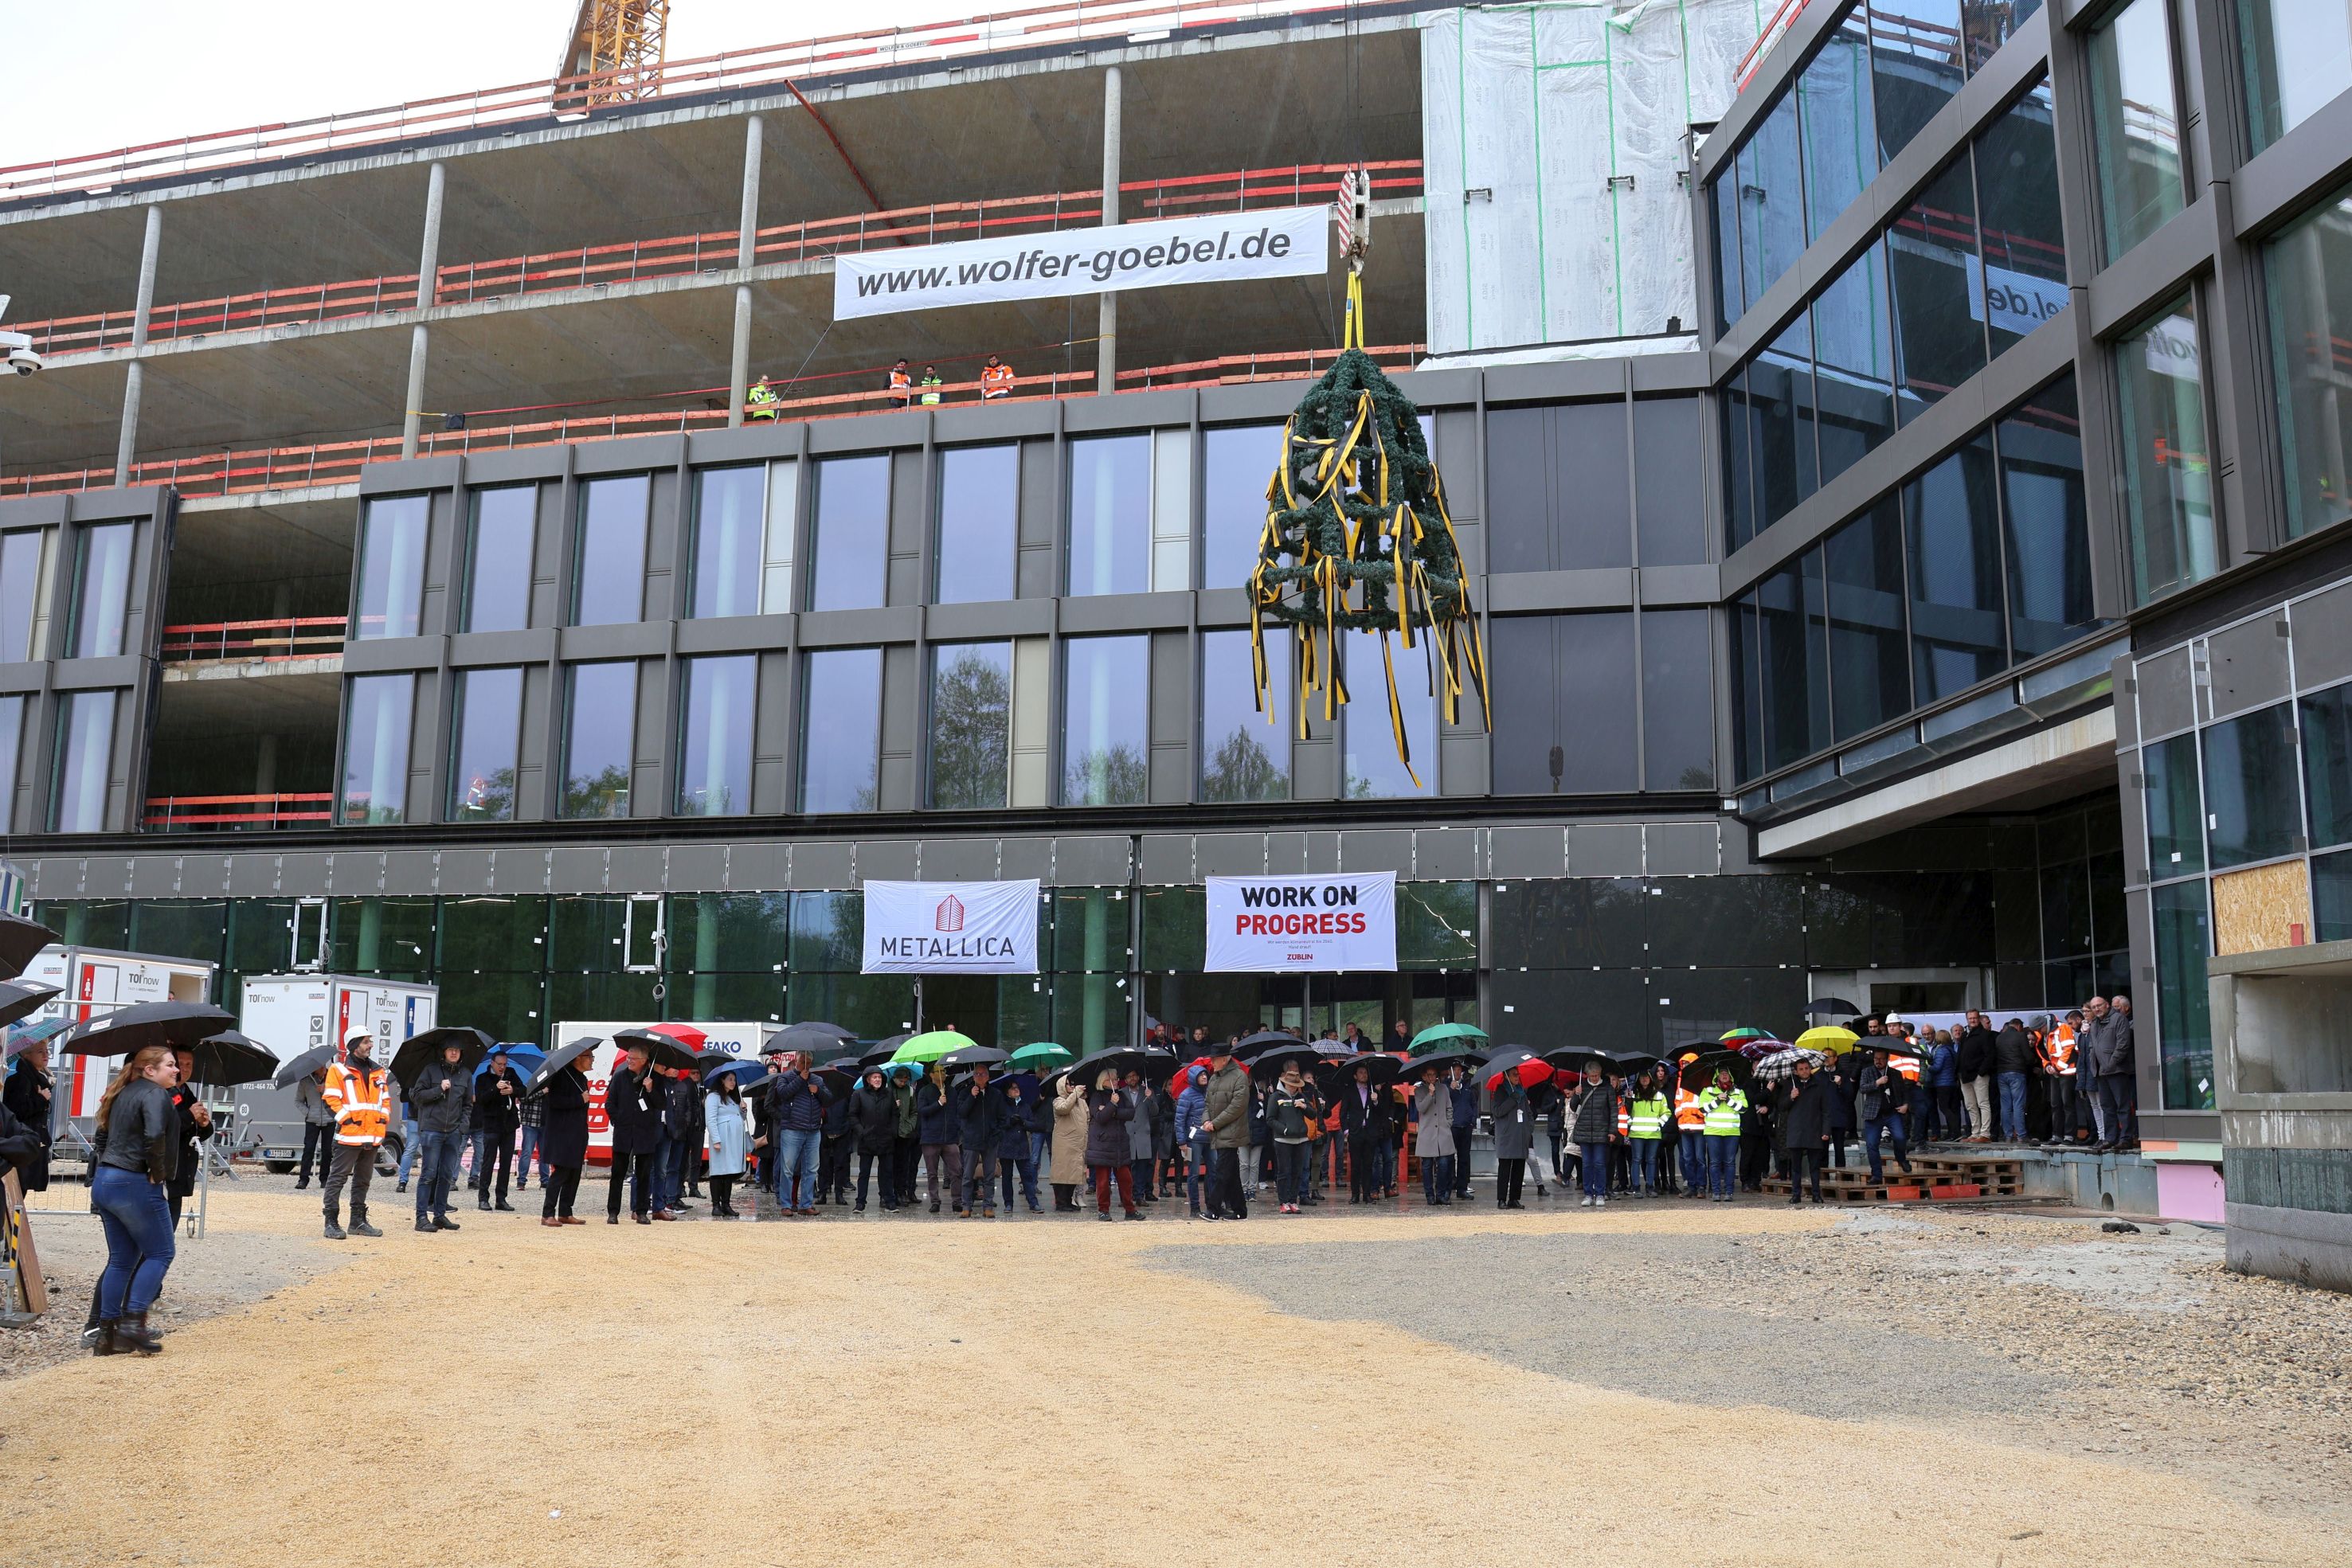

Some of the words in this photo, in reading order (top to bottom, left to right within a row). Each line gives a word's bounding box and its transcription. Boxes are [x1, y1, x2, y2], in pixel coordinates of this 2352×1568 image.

[857, 228, 1291, 297] www.wolfer-goebel.de
[1241, 886, 1317, 907] WORK
[1323, 886, 1357, 906] ON
[1236, 913, 1366, 936] PROGRESS
[881, 936, 1016, 957] METALLICA
[143, 977, 159, 986] now
